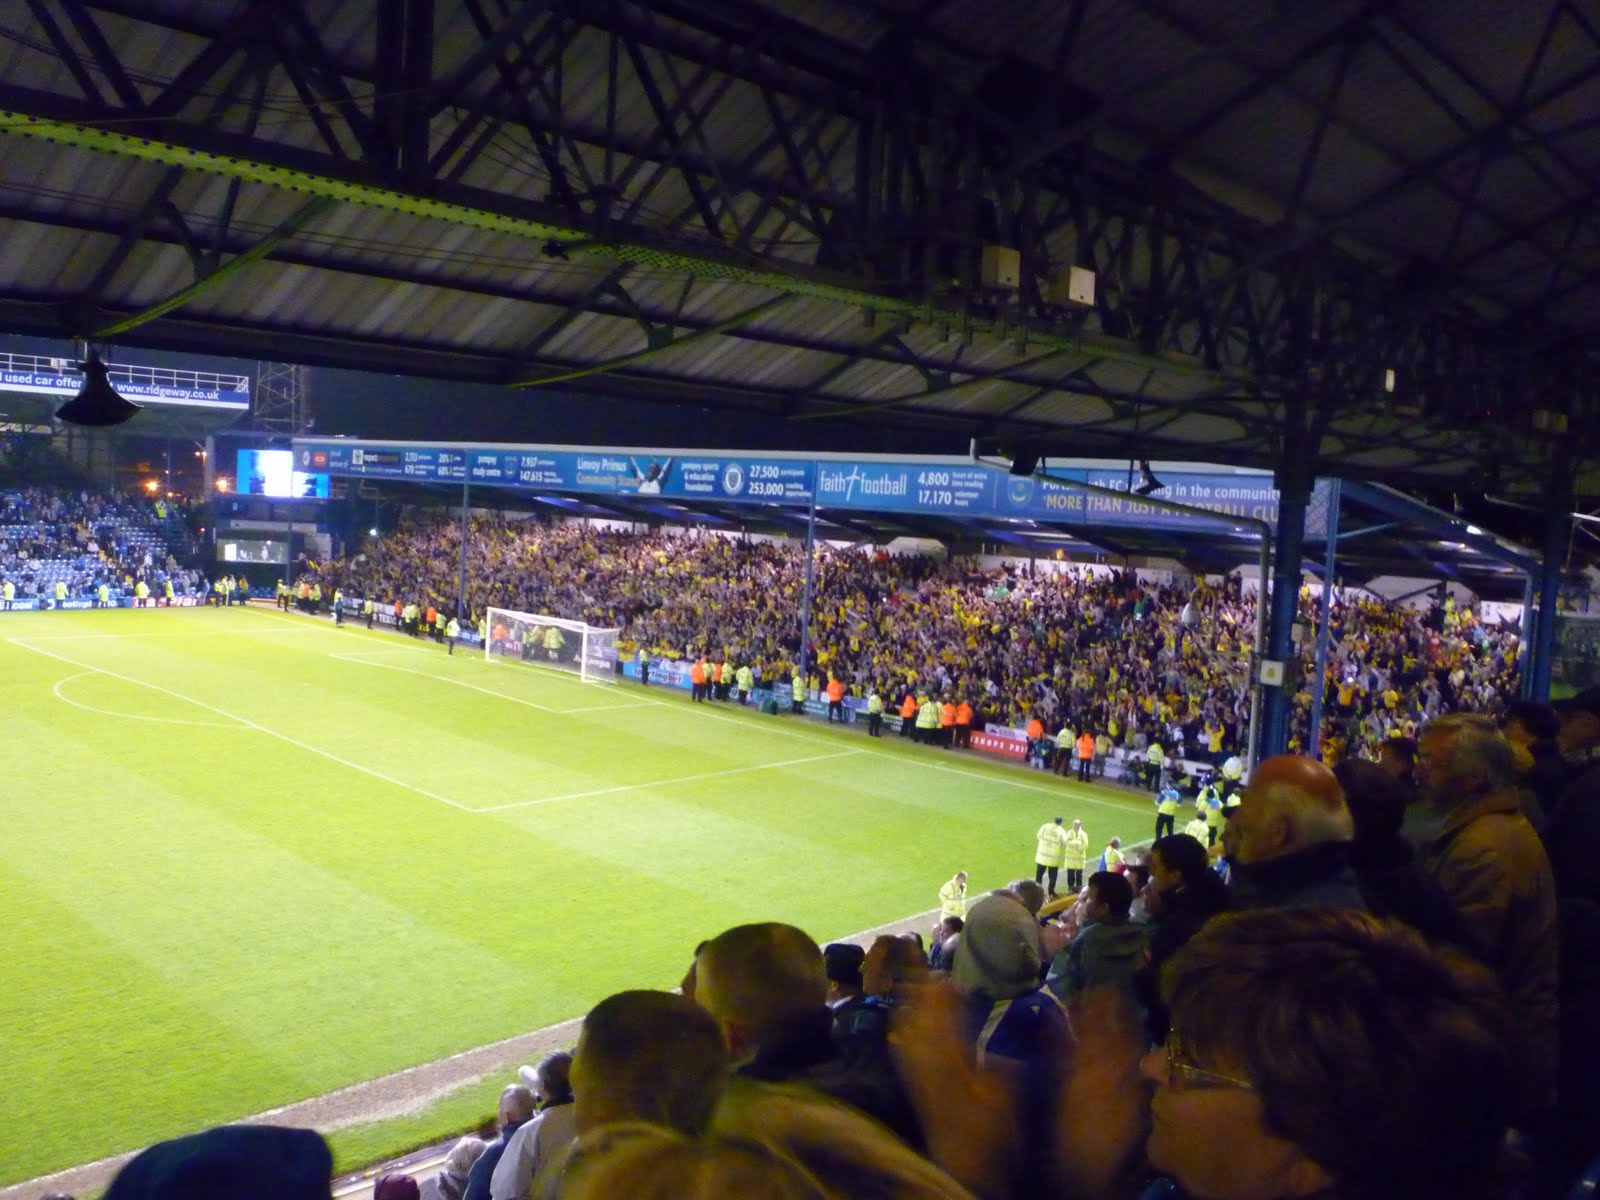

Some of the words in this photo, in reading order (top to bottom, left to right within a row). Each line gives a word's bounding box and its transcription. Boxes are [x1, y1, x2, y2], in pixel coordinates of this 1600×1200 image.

[5, 374, 32, 384] used
[35, 377, 52, 386] car
[117, 384, 219, 400] www.ridgeway.co.uk
[750, 465, 779, 479] 27,500
[918, 472, 949, 487] 4,800
[749, 482, 784, 496] 253,000
[820, 471, 846, 493] faith
[860, 473, 907, 495] football
[1176, 483, 1187, 497] in
[1191, 484, 1211, 498] the
[918, 490, 952, 505] 17,170
[1086, 497, 1122, 512] THAN
[634, 668, 682, 683] sprtingbet
